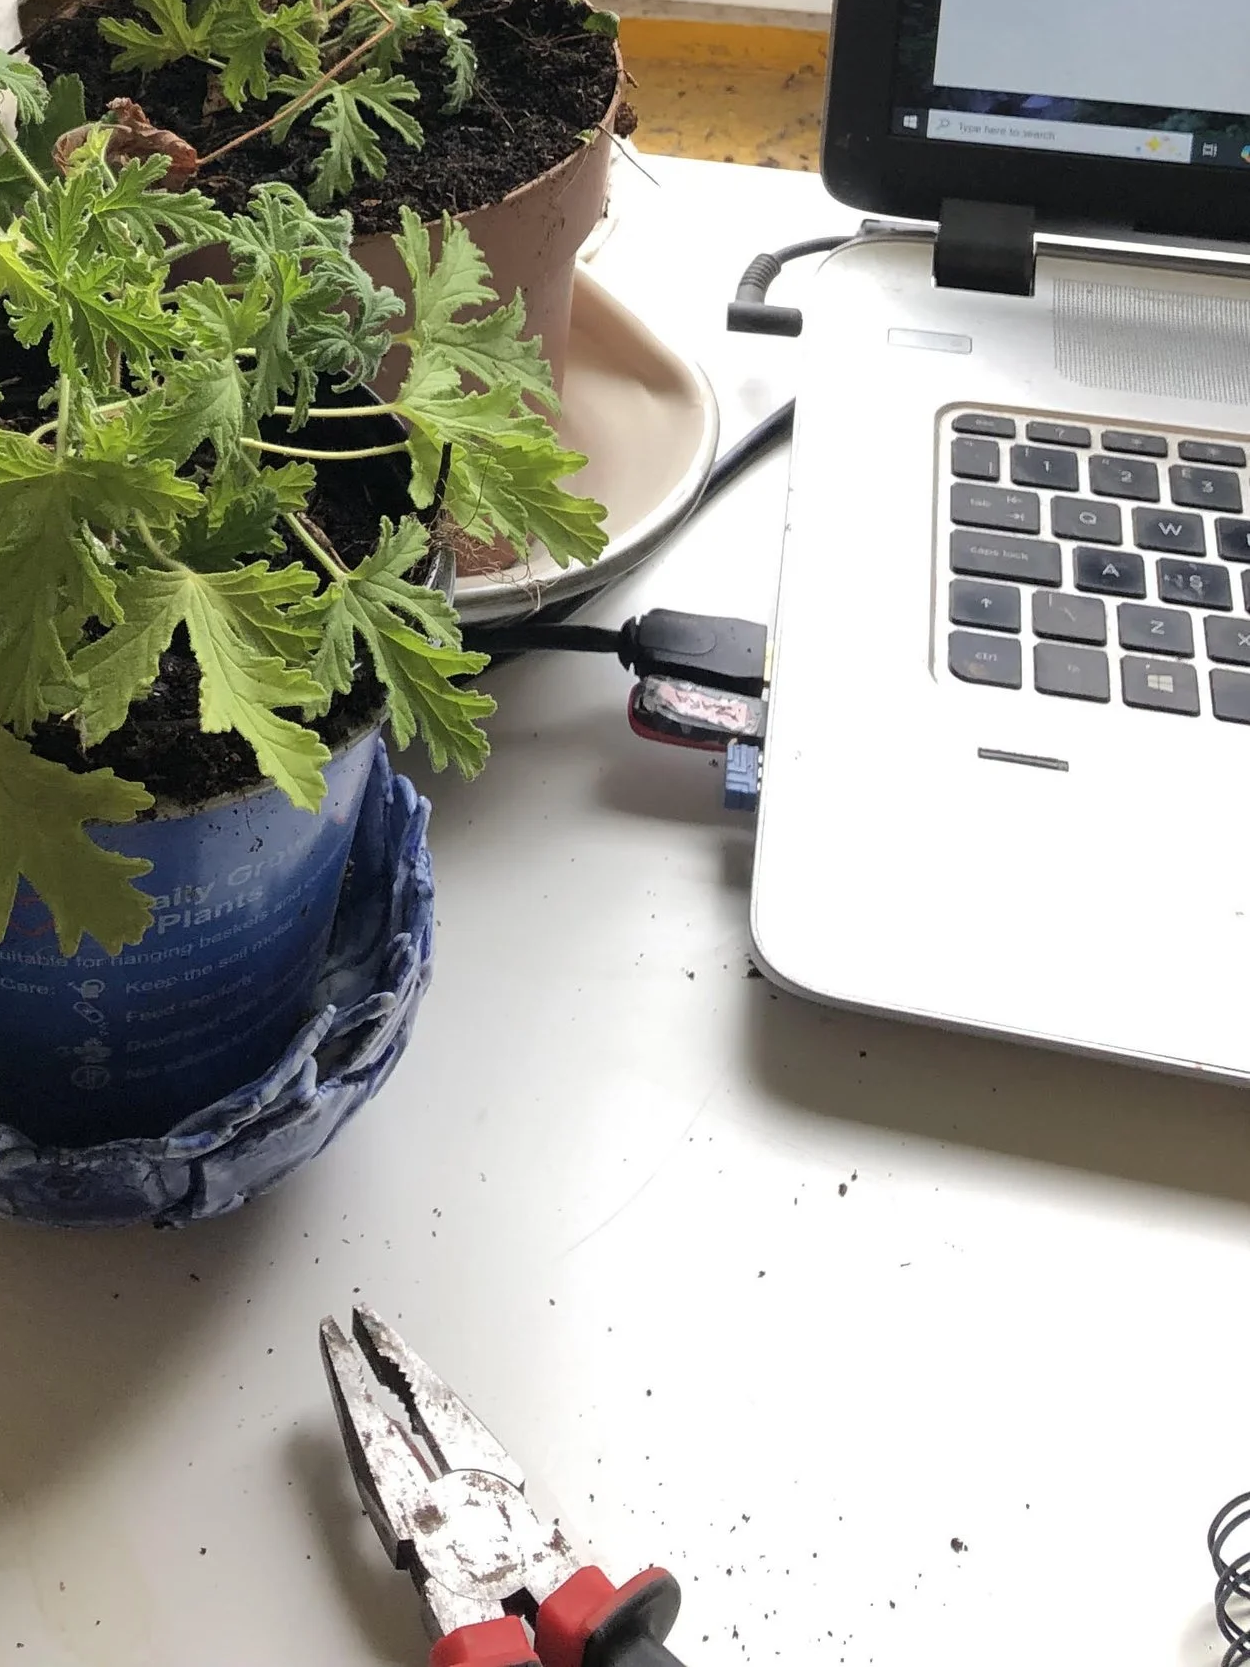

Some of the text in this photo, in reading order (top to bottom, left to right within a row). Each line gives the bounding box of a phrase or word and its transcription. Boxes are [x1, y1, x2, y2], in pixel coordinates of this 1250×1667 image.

[959, 121, 1056, 141] Type here to search
[1158, 522, 1183, 536] W
[1102, 563, 1120, 578] A
[1150, 620, 1165, 635] Z
[975, 652, 998, 662] ctrl
[156, 884, 265, 934] Plants
[126, 971, 180, 995] Keep
[183, 963, 213, 981] the
